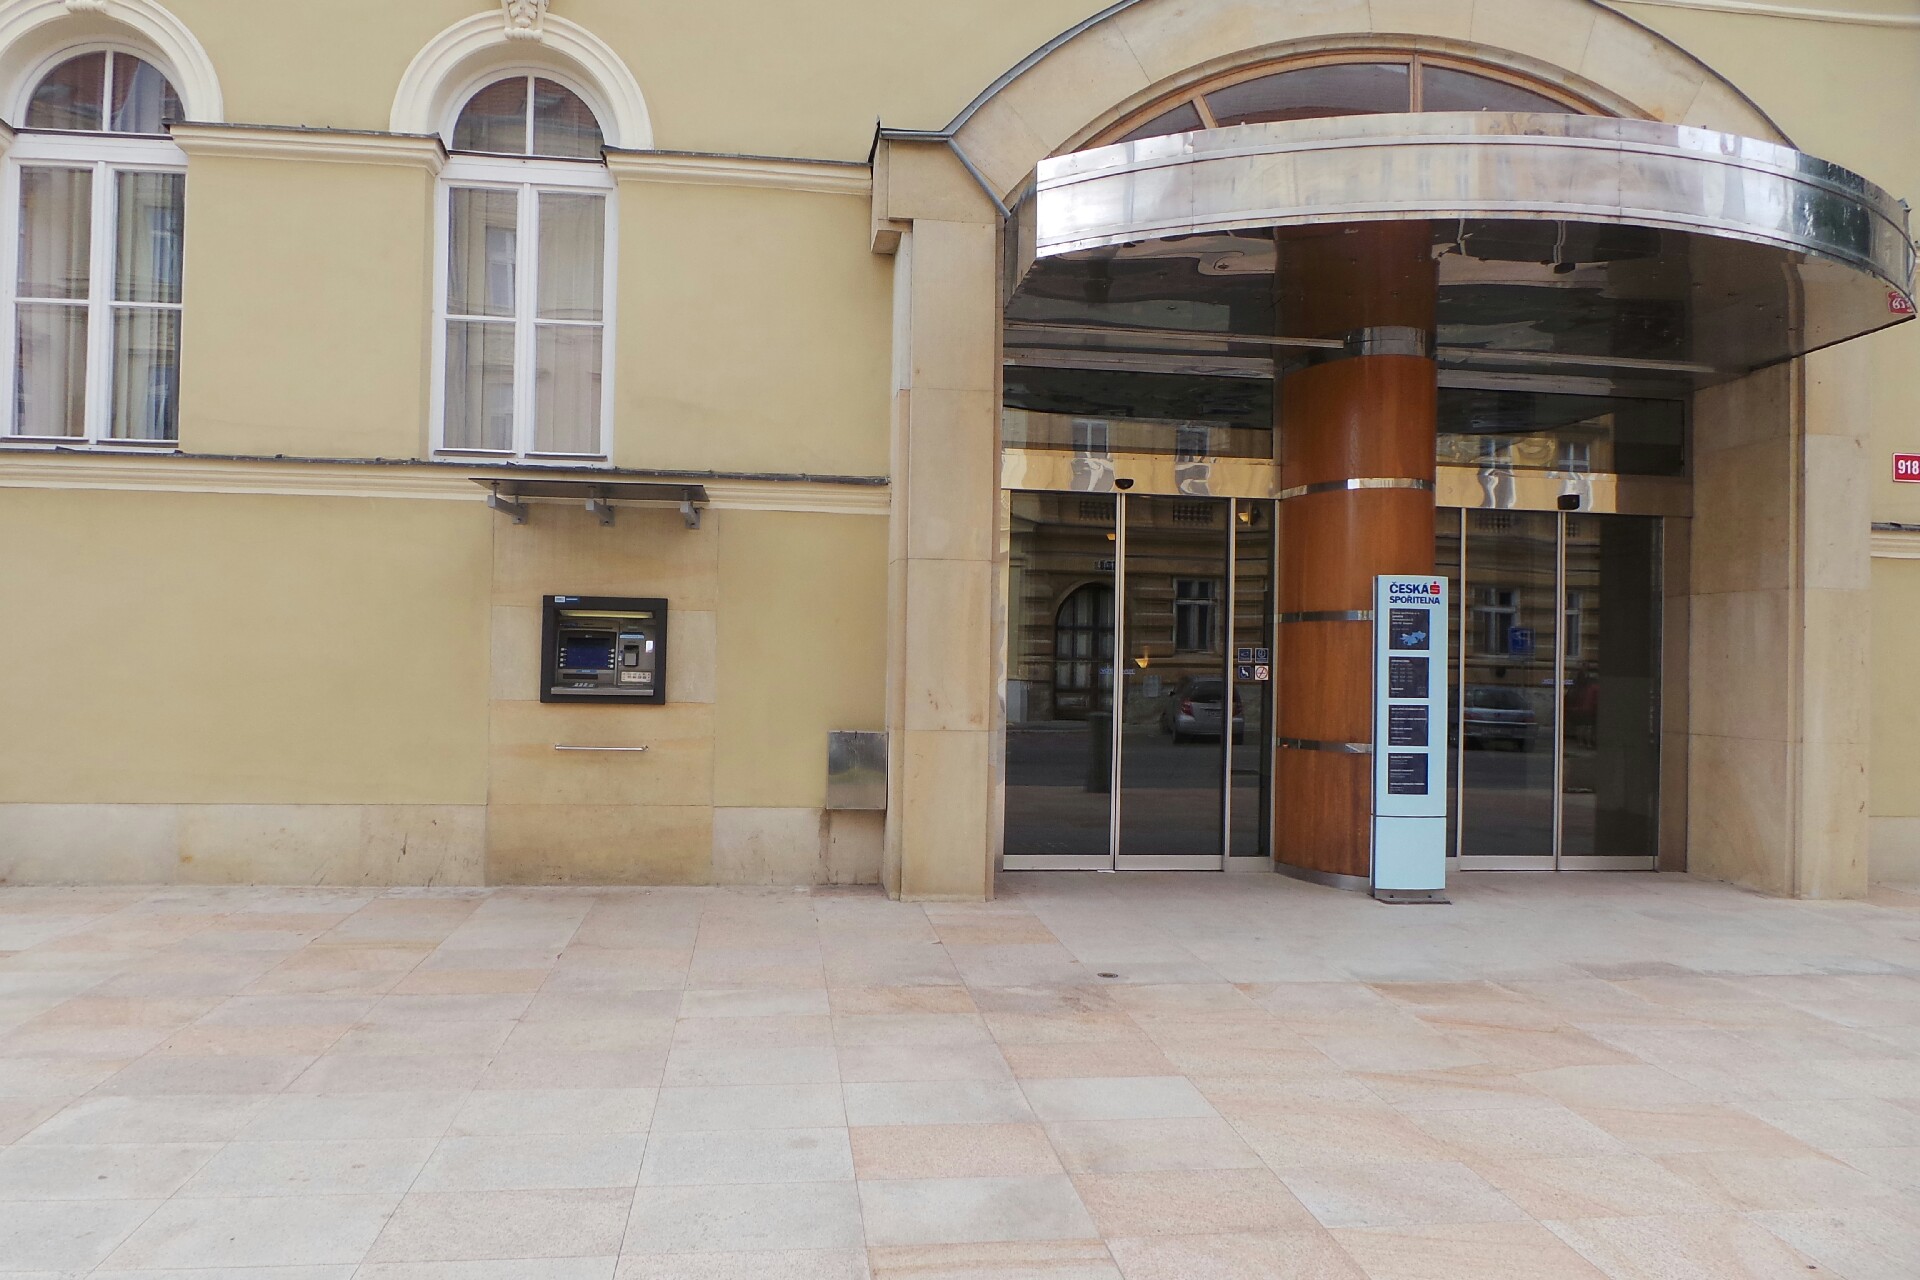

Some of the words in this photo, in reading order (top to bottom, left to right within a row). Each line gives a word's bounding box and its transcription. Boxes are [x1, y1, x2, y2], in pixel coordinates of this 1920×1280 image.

[1898, 460, 1919, 475] 918
[1389, 581, 1429, 594] ČESKÁ
[1389, 595, 1440, 605] SPOŘITELNA
